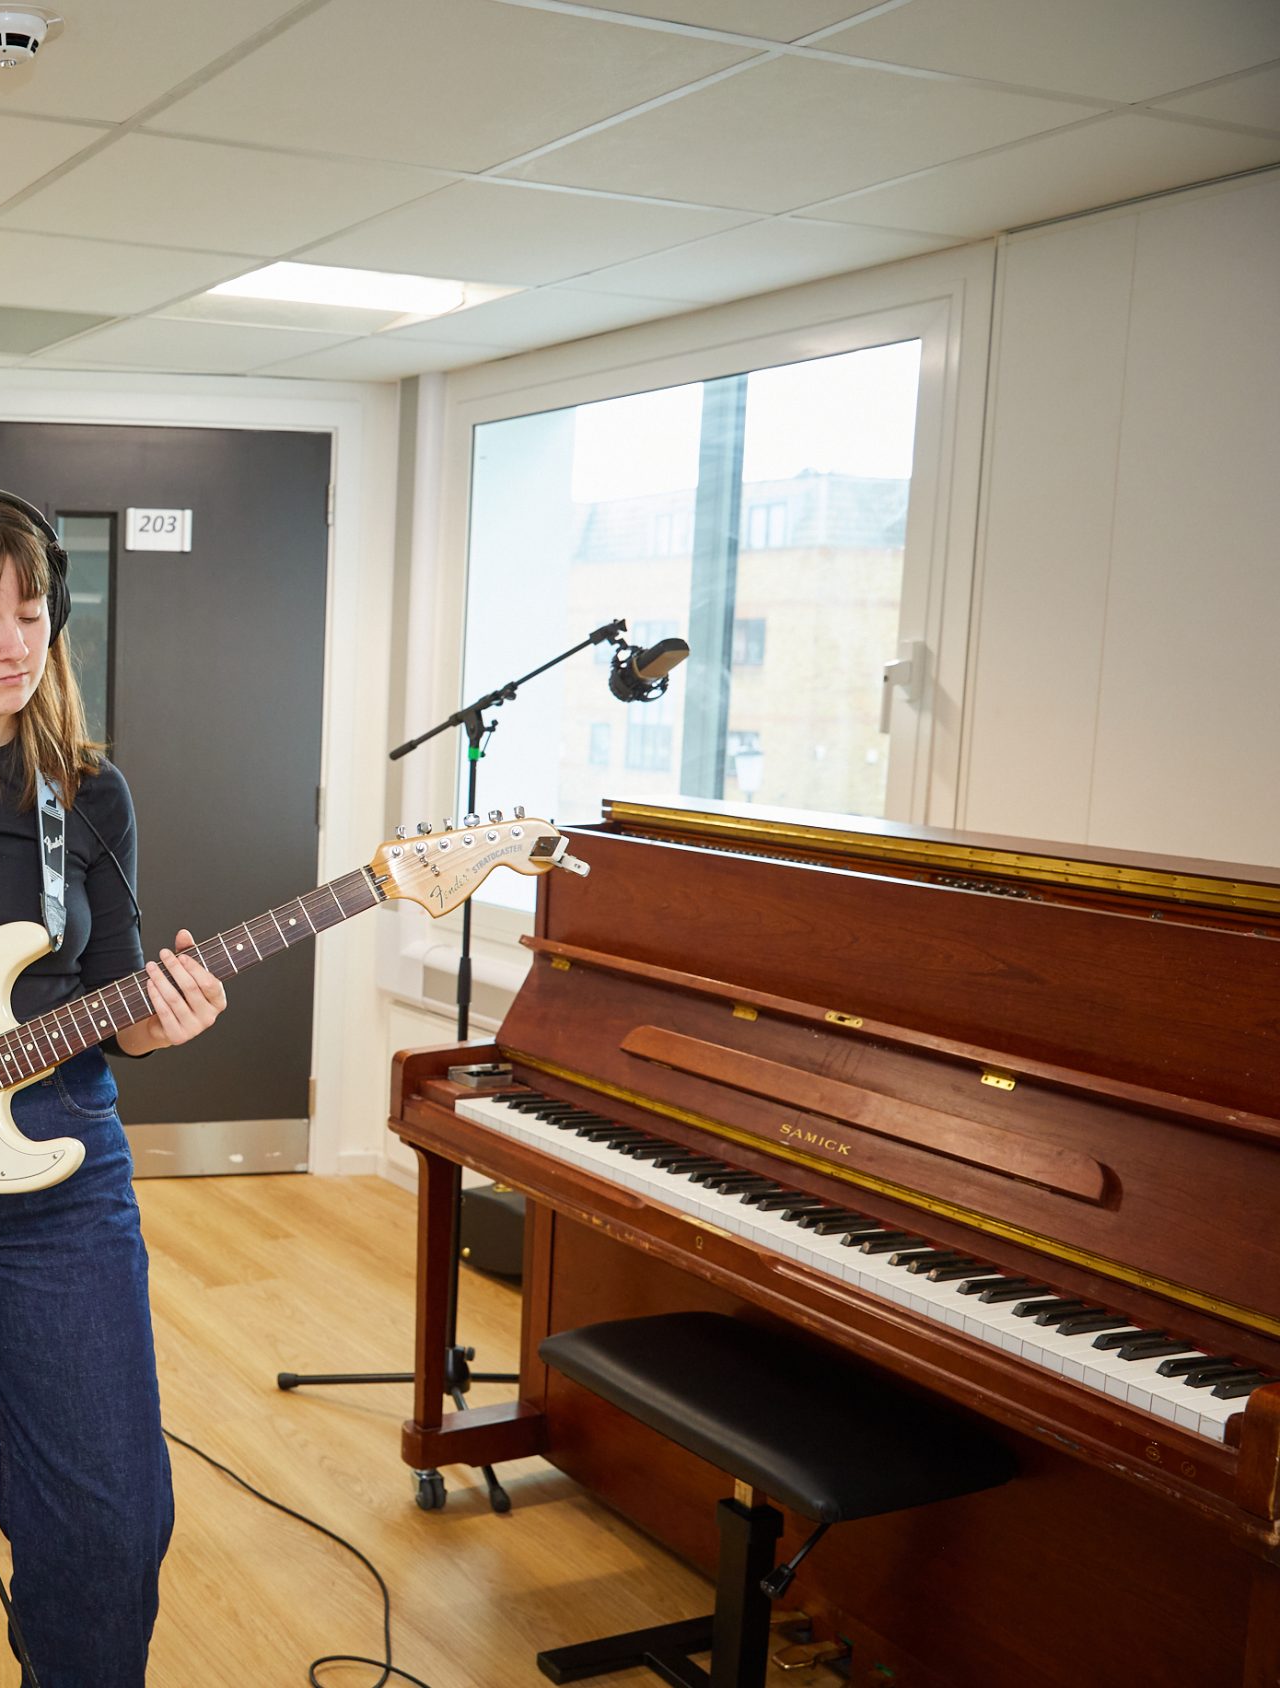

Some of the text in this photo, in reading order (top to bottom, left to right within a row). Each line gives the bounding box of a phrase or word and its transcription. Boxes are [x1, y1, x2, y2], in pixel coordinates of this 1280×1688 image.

[139, 515, 177, 533] 203
[472, 844, 523, 874] STRATOCASTER
[429, 873, 469, 909] Fender
[779, 1123, 852, 1155] SAMICK
